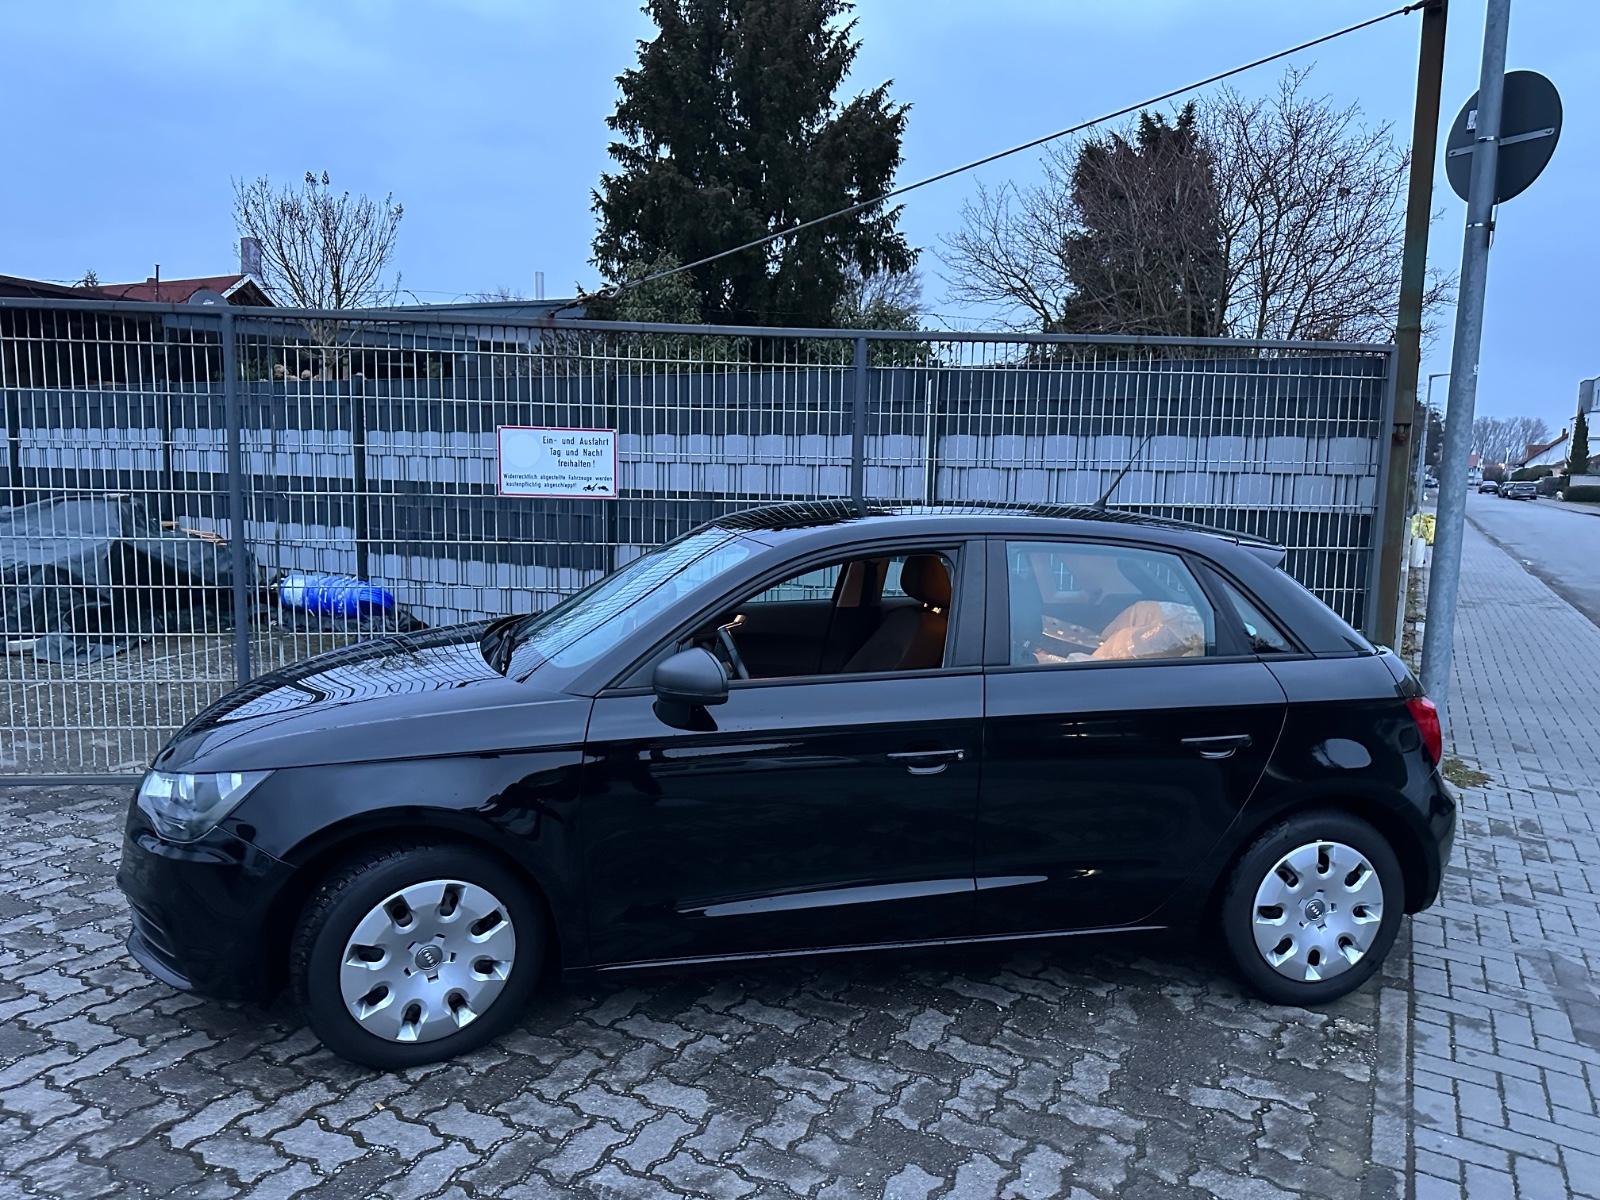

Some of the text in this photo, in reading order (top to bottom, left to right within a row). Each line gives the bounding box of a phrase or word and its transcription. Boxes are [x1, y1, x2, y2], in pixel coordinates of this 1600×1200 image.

[542, 436, 608, 446] Ein- und Ausfahrt
[550, 448, 561, 458] Tag
[583, 448, 602, 456] Nacht
